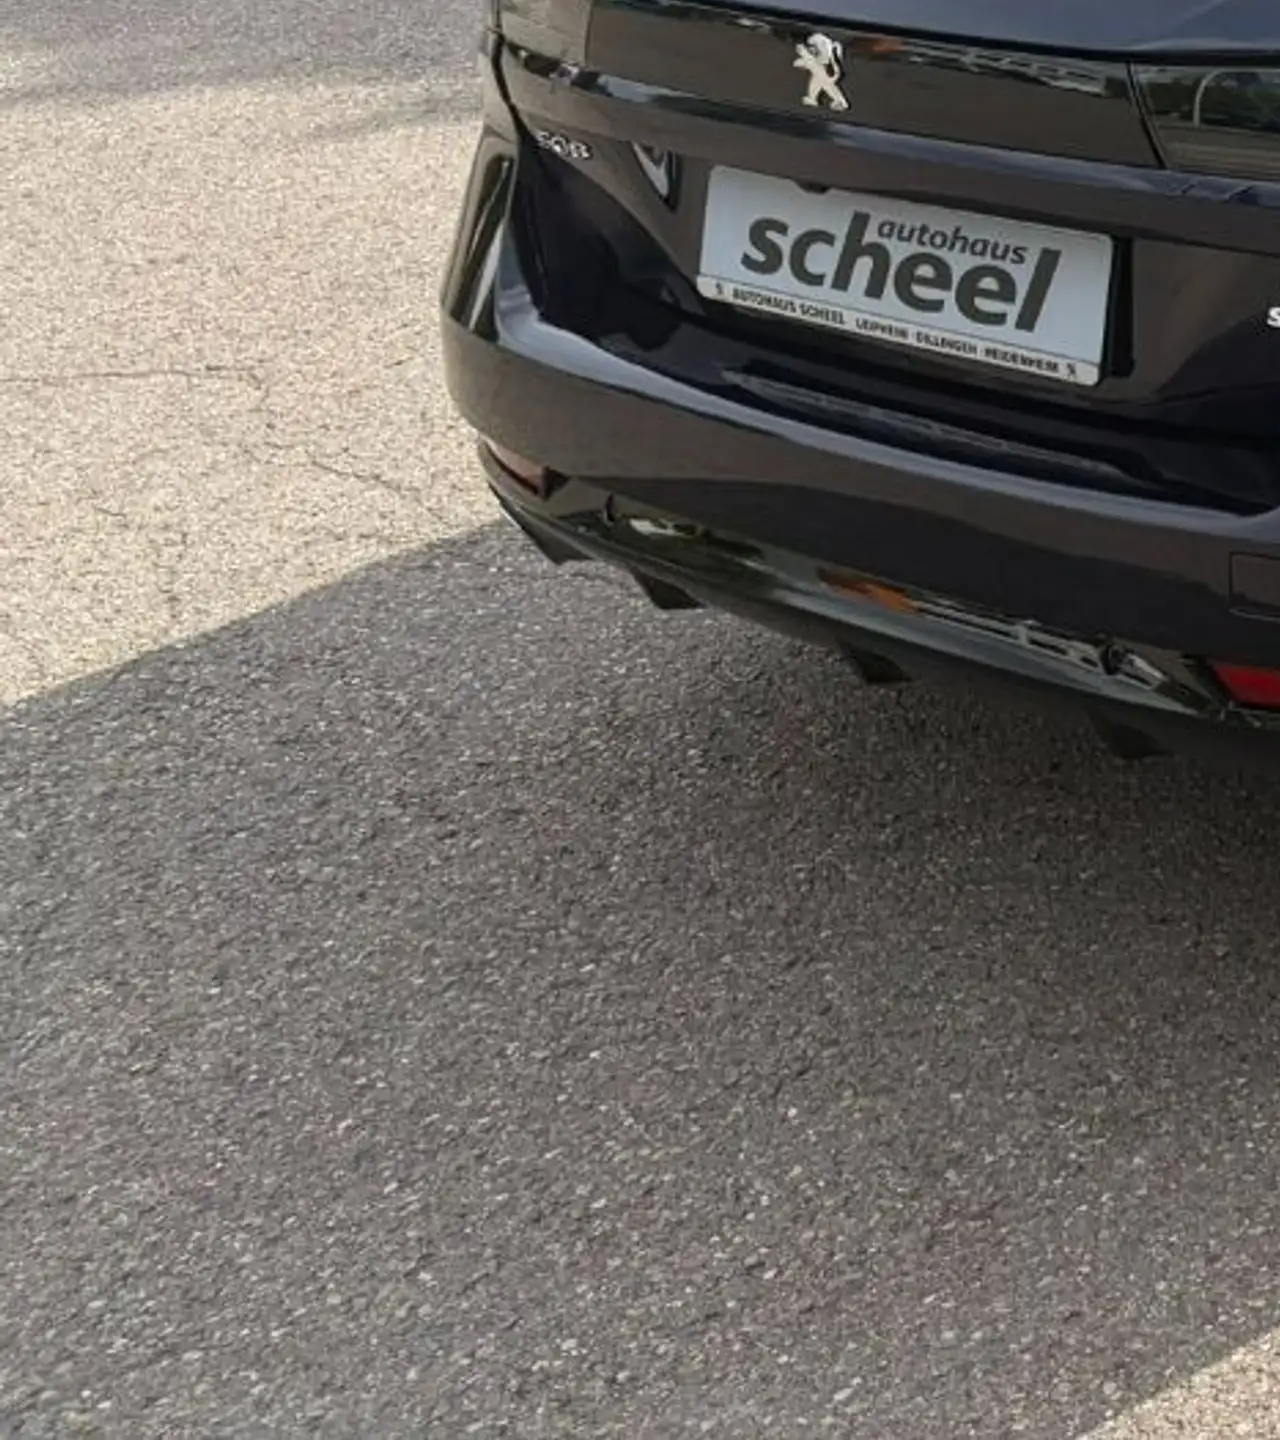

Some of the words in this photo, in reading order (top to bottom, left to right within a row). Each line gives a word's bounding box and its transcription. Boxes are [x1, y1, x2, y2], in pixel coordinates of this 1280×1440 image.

[877, 218, 1029, 265] autohaus
[740, 210, 1062, 333] scheel
[732, 288, 798, 314] AUTOHAUS
[799, 303, 846, 326] SCHEEL
